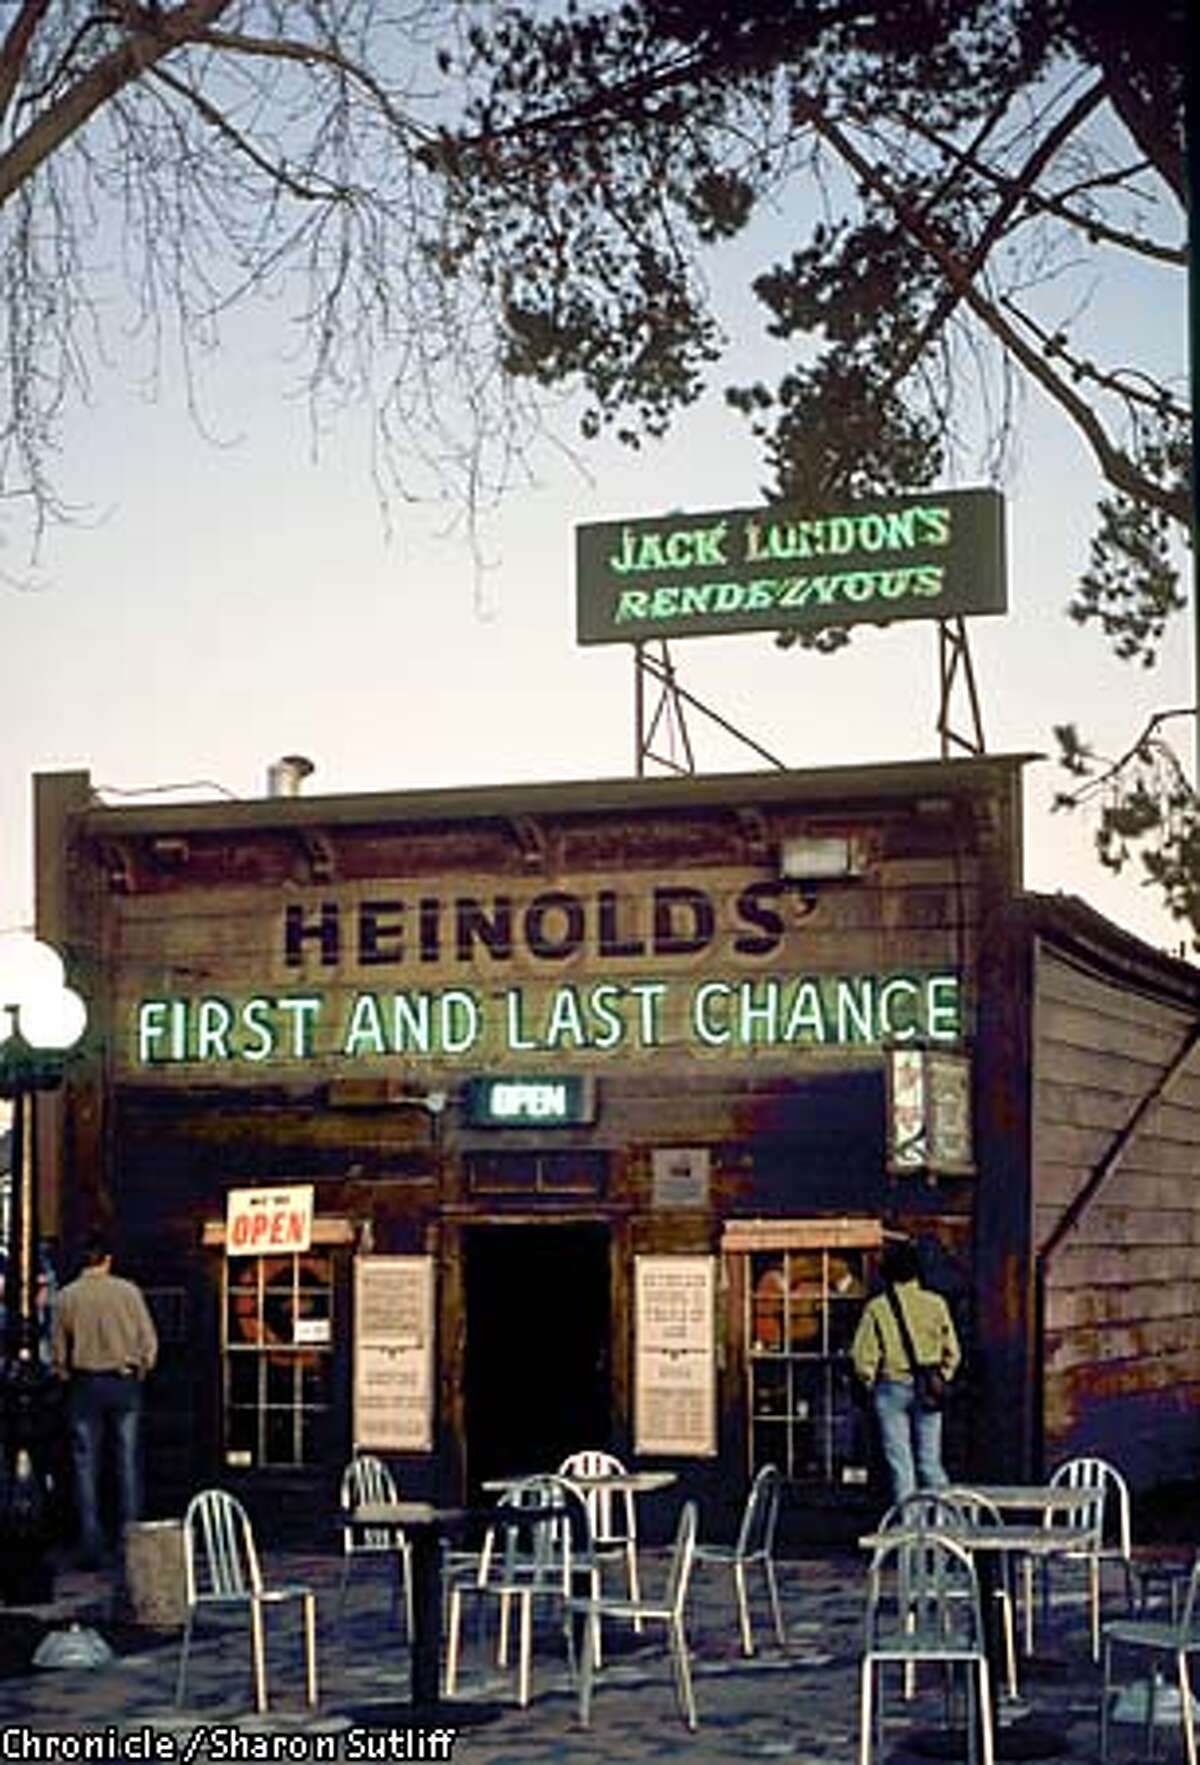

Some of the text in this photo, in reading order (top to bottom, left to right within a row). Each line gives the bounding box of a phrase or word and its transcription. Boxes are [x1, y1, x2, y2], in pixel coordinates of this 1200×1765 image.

[610, 519, 728, 575] JACK
[614, 565, 944, 624] RENDEZVOUS
[284, 879, 818, 967] HEINOLDS'
[138, 977, 961, 1062] FIRST AND LAST CHANCE
[489, 1083, 566, 1116] OPEN
[231, 1210, 306, 1248] OPEN
